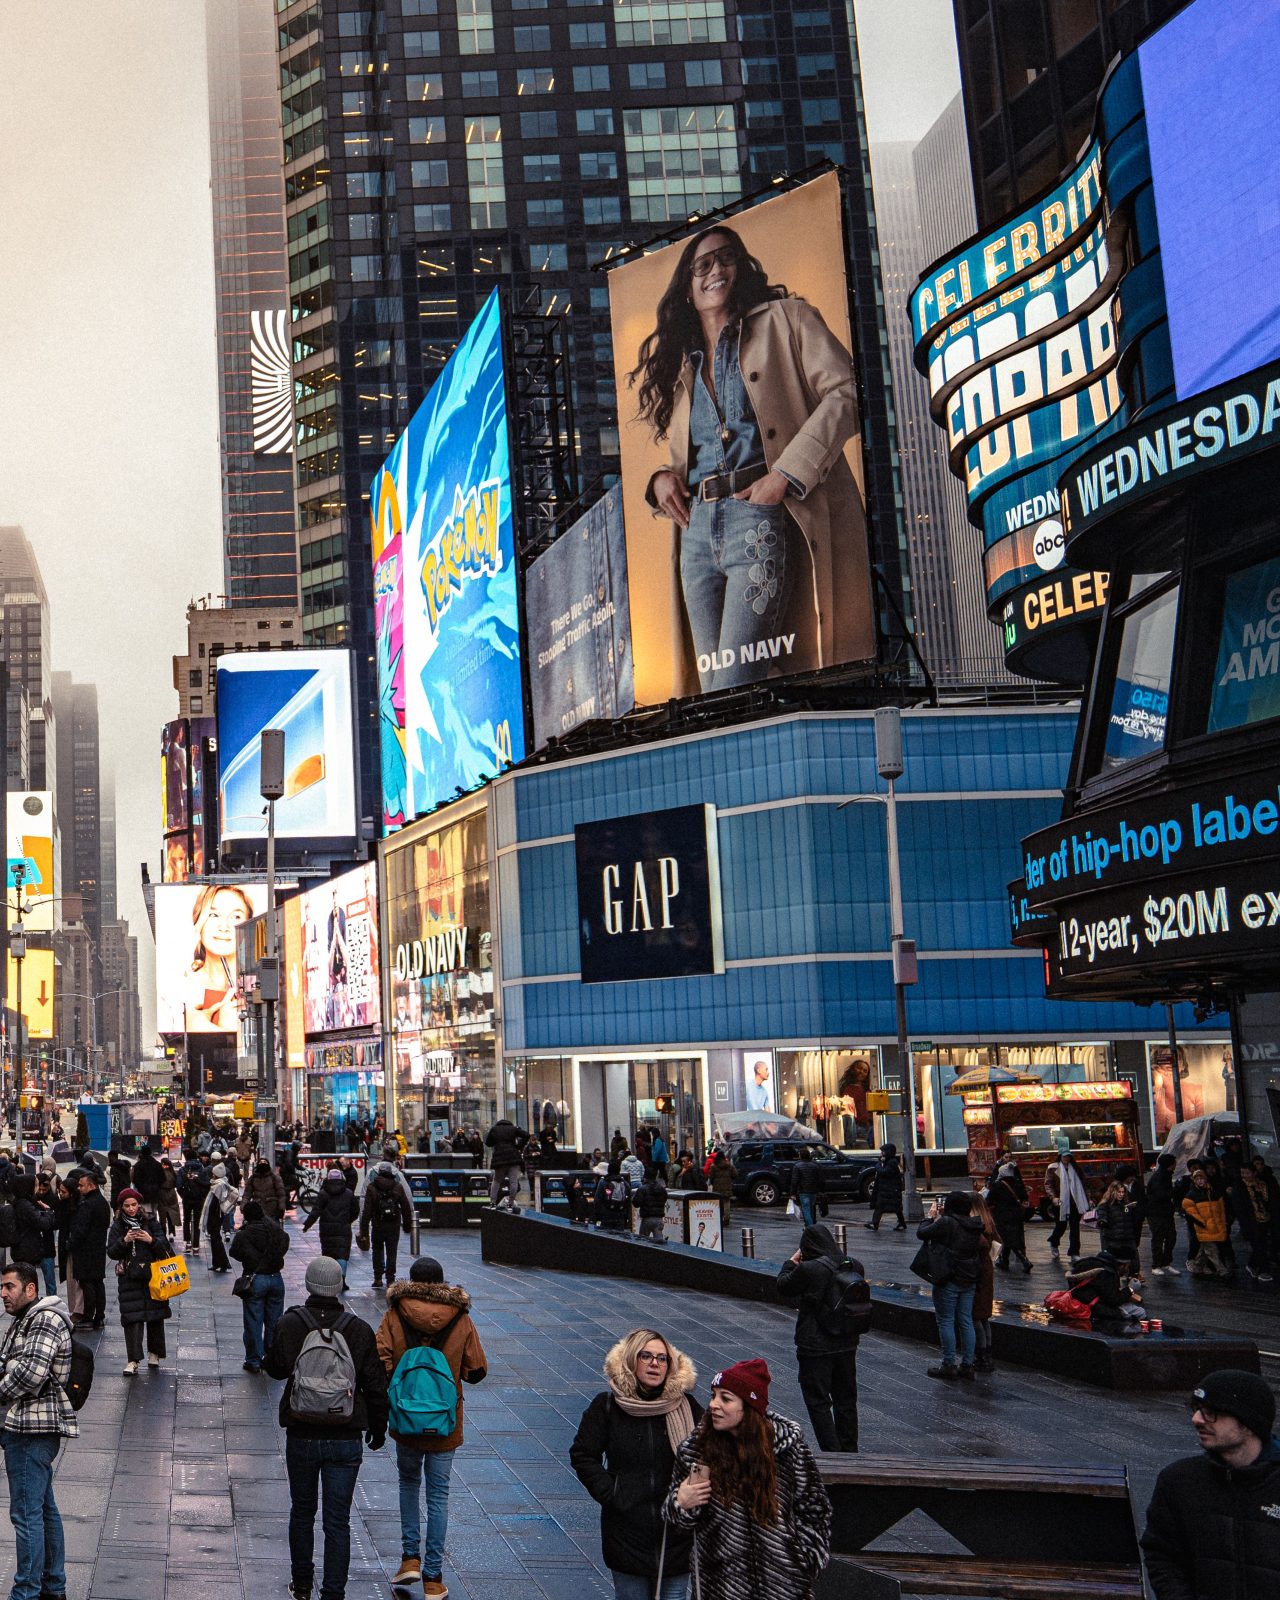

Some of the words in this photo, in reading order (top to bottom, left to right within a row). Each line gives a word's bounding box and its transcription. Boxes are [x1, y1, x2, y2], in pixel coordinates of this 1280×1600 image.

[1035, 534, 1065, 555] abc
[538, 639, 566, 669] Stopping
[566, 618, 590, 648] Traffic
[592, 602, 616, 630] Again.
[551, 610, 570, 635] There
[571, 601, 583, 622] We
[697, 649, 735, 673] OLD
[740, 633, 795, 664] NAVY
[562, 708, 575, 730] OLD
[576, 697, 595, 722] NAVY
[1049, 839, 1067, 882] of
[1072, 819, 1182, 880] hip-hop
[1191, 795, 1280, 848] labe
[602, 857, 680, 935] GAP
[1071, 913, 1138, 963] 2-year,
[1143, 886, 1230, 948] $20M
[396, 941, 424, 980] OLD
[425, 926, 468, 975] NAVY
[424, 1057, 436, 1074] OLD
[437, 1056, 454, 1074] NAVY
